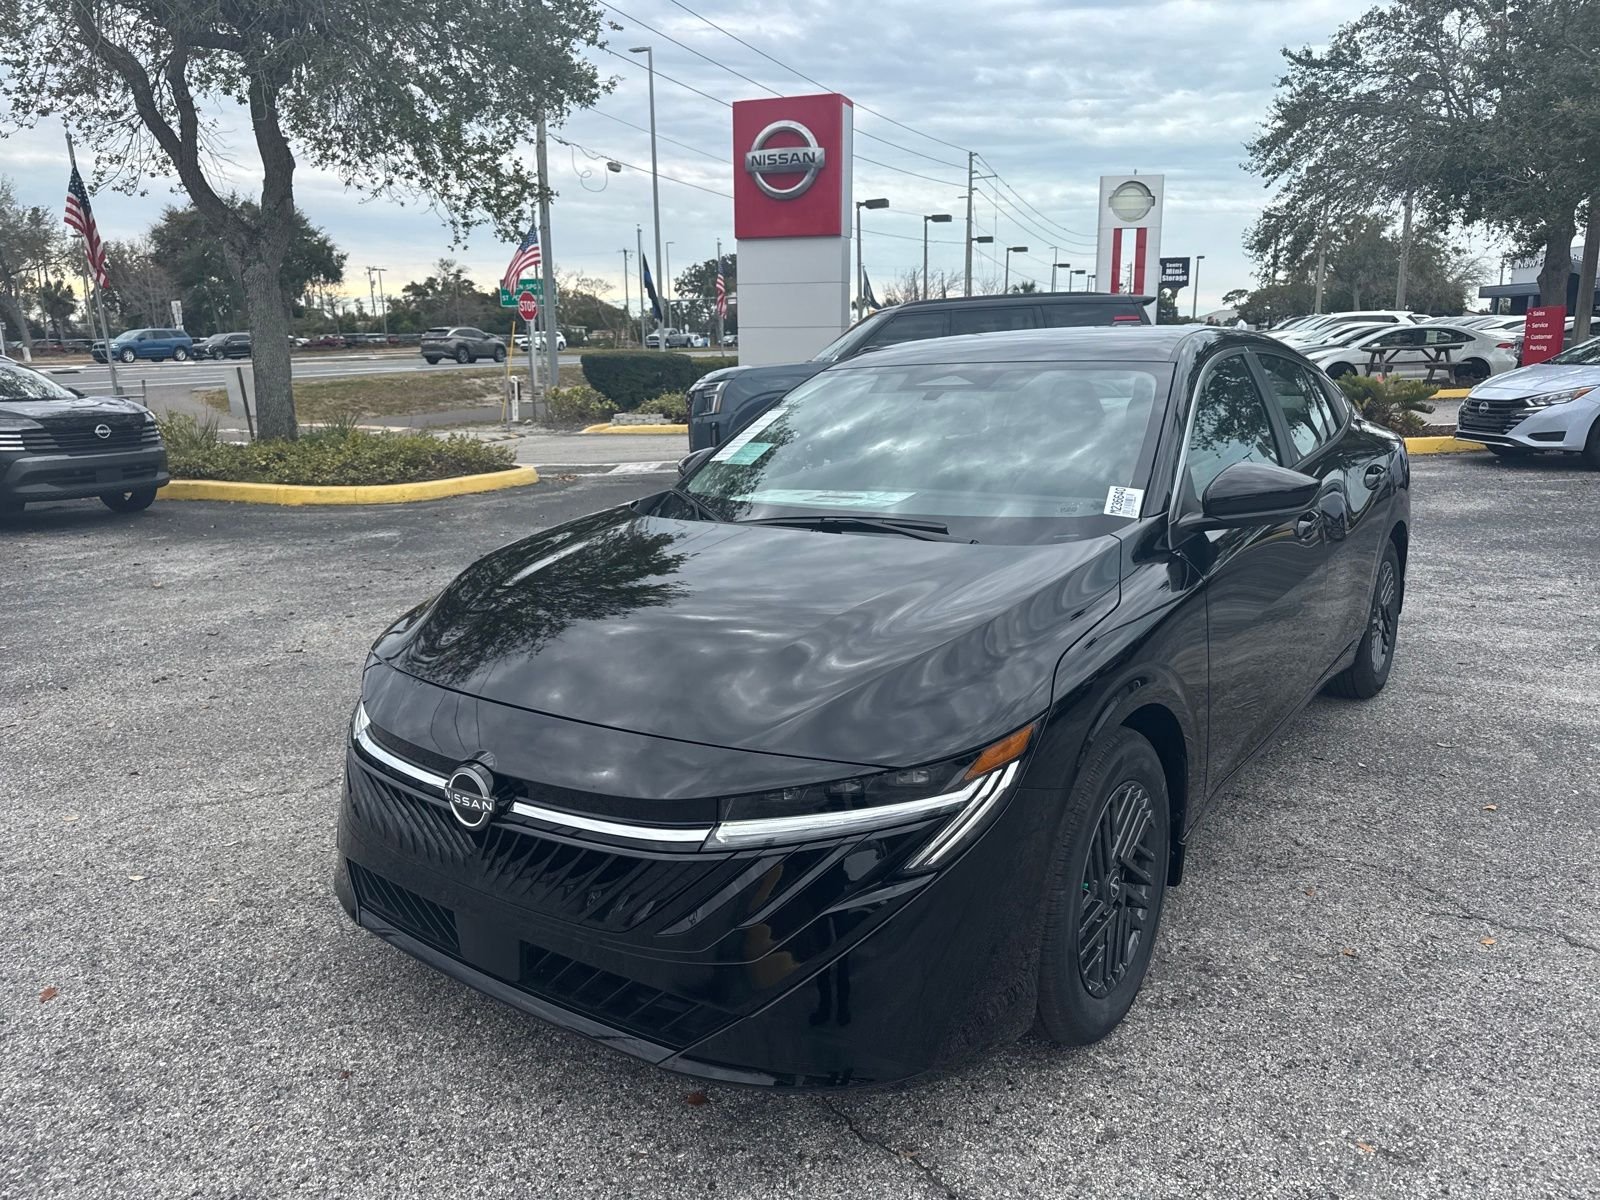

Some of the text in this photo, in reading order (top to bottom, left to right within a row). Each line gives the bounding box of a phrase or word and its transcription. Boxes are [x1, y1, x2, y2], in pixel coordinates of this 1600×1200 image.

[751, 152, 816, 167] NISSAN
[520, 300, 536, 312] STOP
[445, 788, 493, 811] NISSAN
